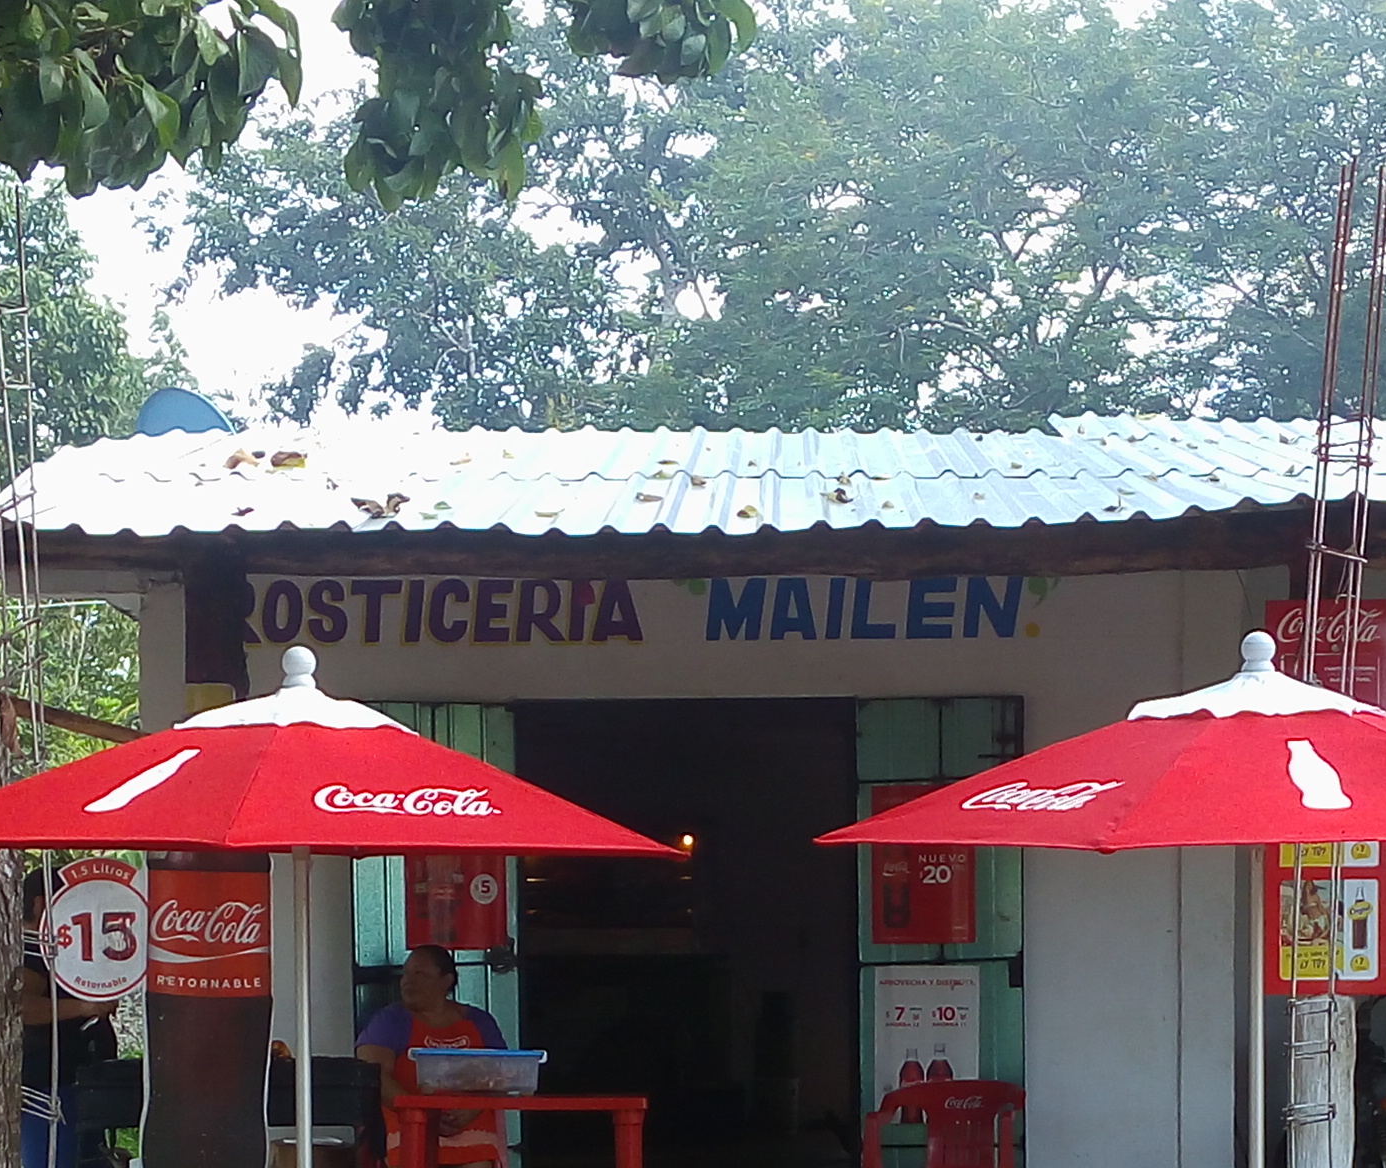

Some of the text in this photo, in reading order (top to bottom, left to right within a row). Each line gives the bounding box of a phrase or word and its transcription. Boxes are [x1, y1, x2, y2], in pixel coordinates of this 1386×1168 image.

[918, 854, 966, 863] NUEVO
[150, 900, 266, 943] Coca-Cola
[156, 975, 262, 989] RETORNABLE
